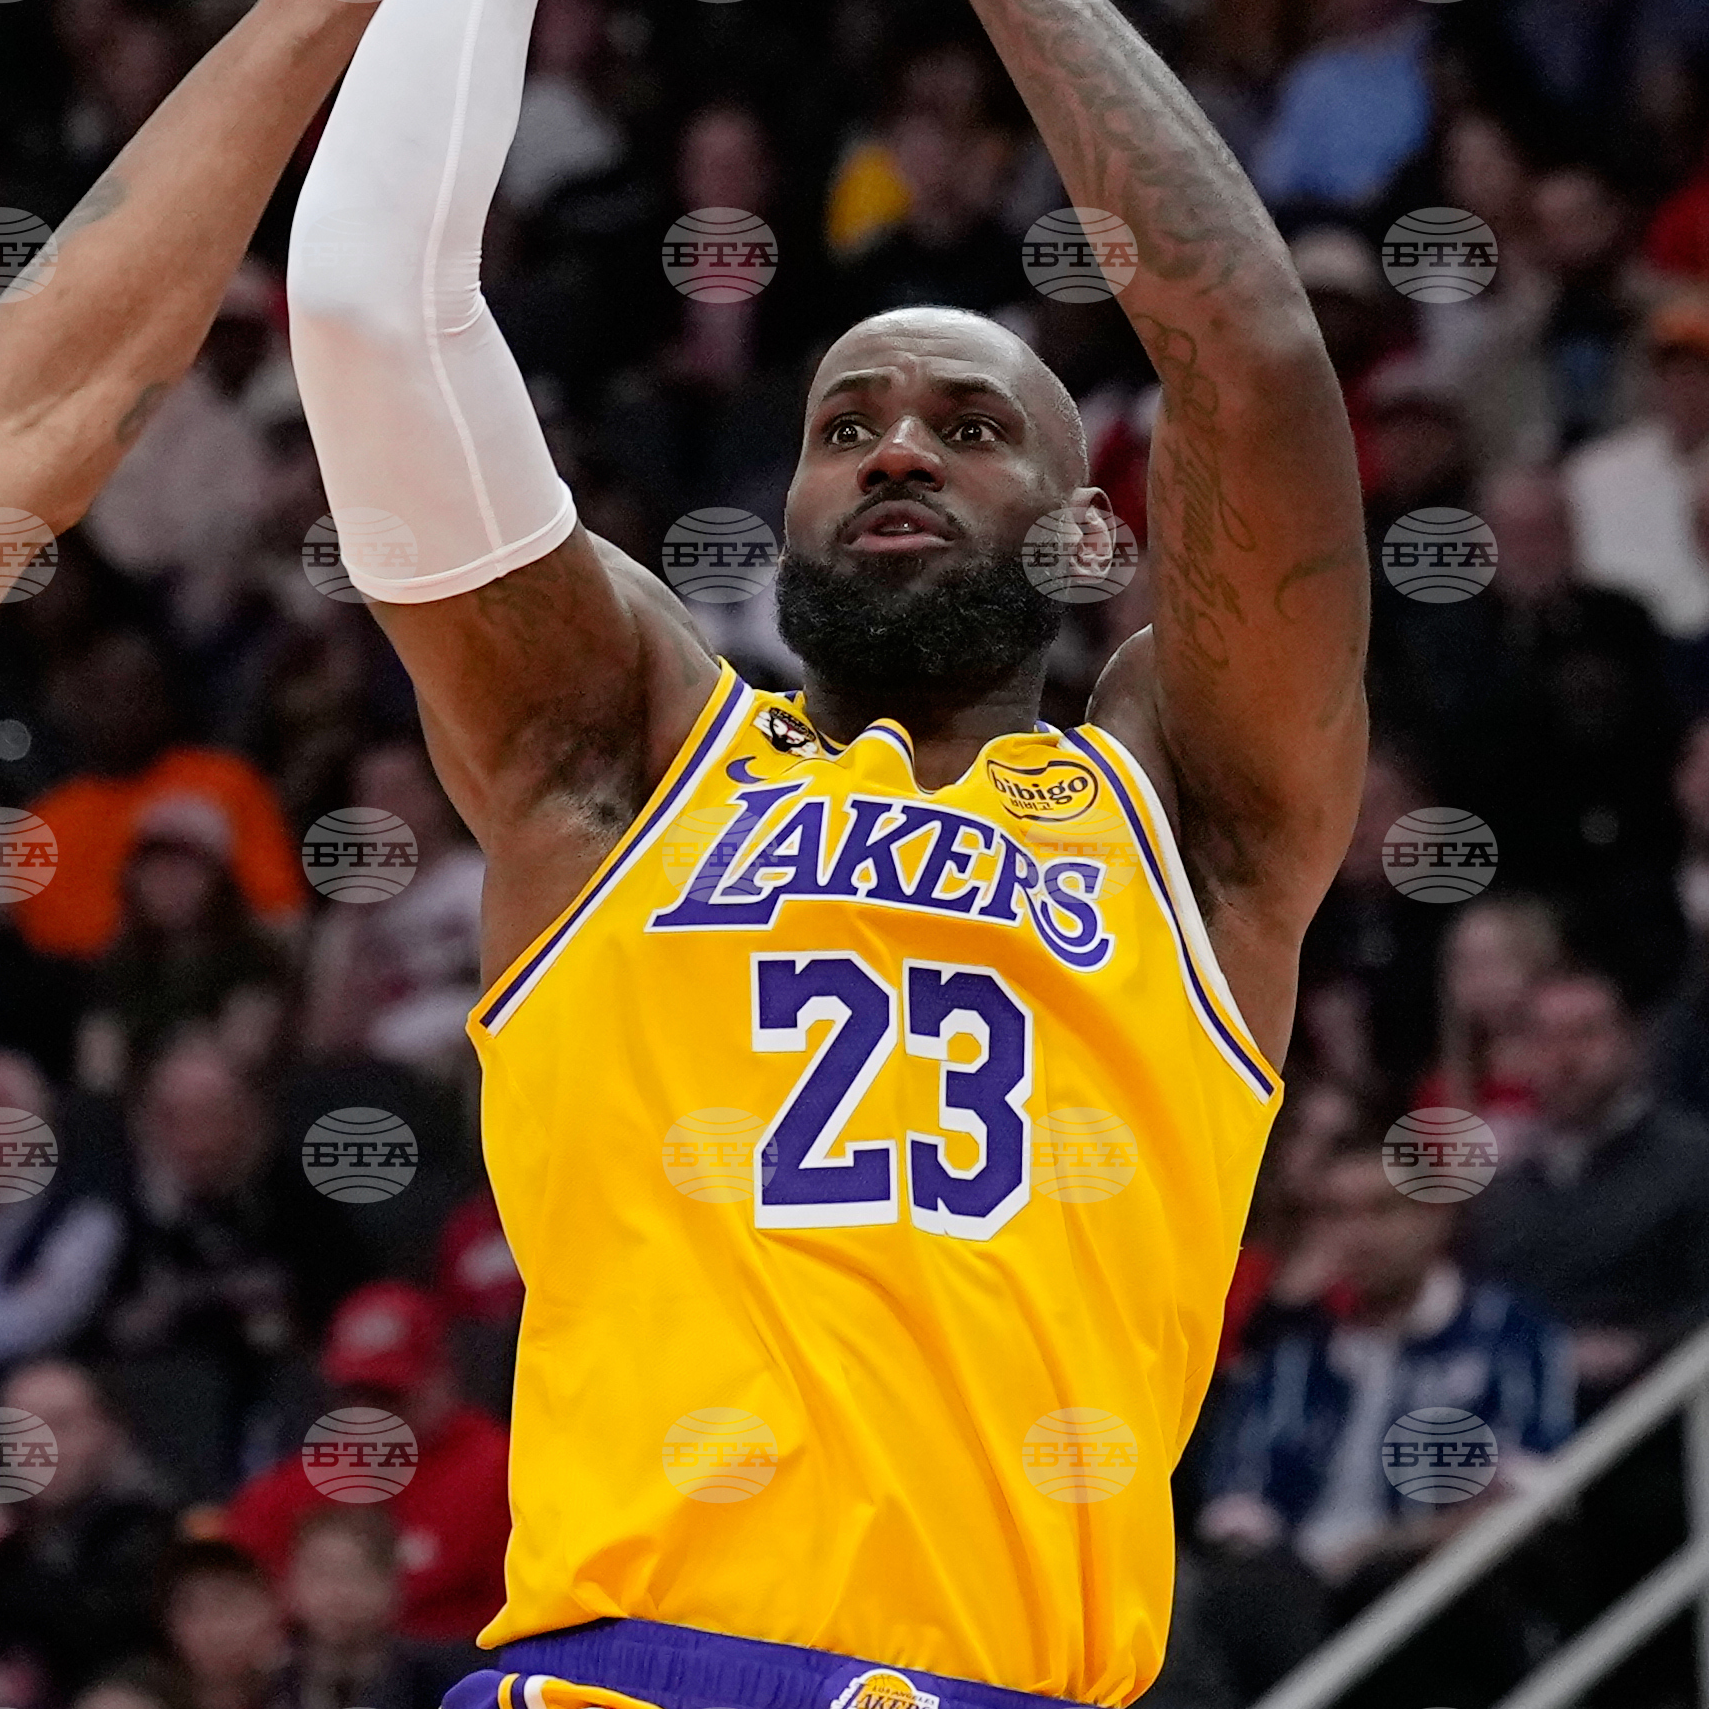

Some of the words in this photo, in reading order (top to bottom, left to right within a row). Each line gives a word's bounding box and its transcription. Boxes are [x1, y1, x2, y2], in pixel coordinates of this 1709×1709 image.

[991, 769, 1089, 805] bibigo
[1009, 798, 1054, 811] 비비고
[645, 777, 1116, 973] LAKERS
[750, 950, 1034, 1241] 23
